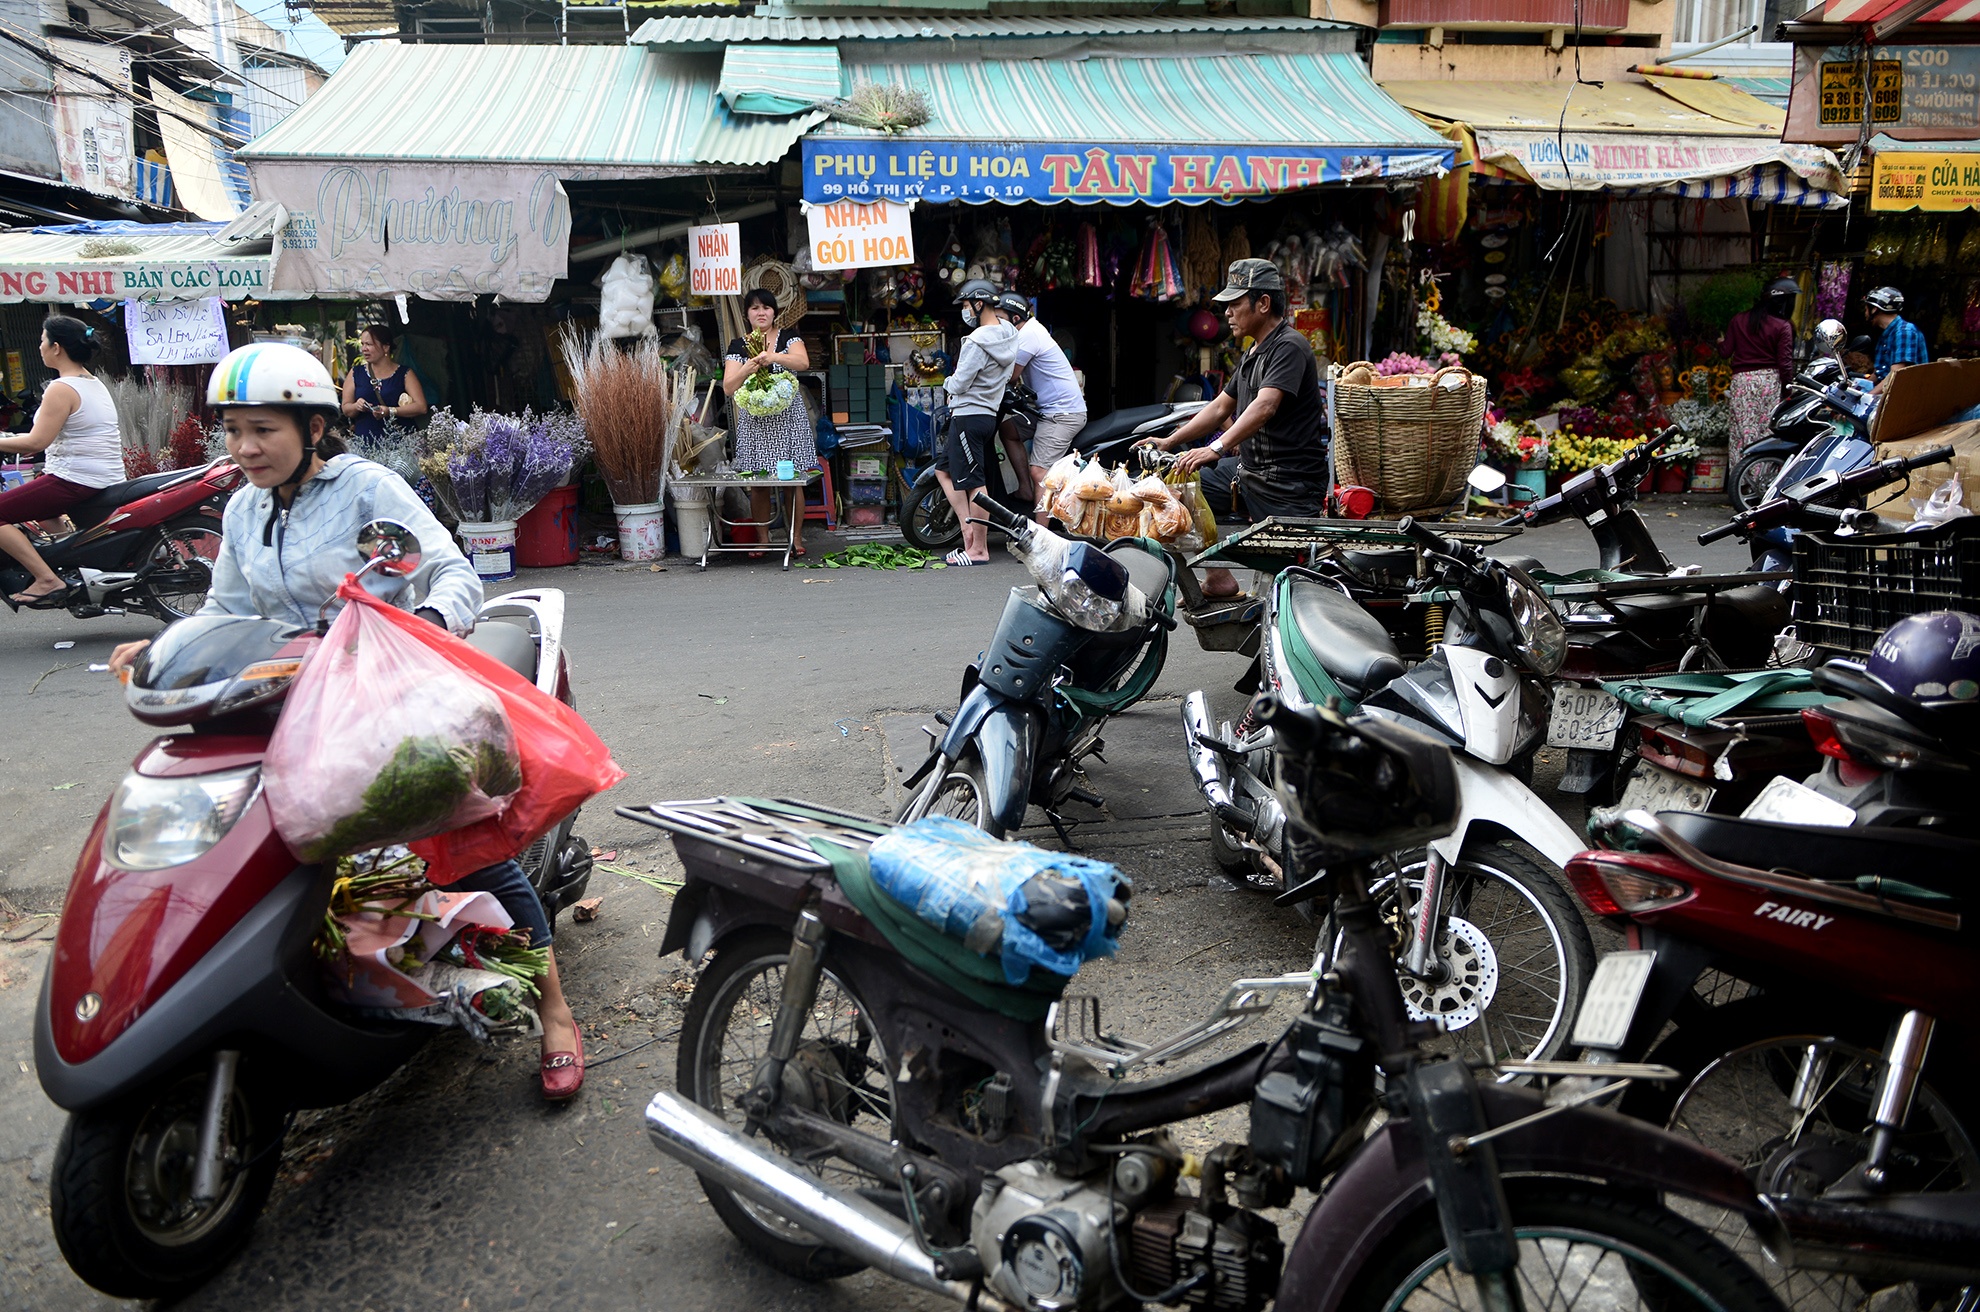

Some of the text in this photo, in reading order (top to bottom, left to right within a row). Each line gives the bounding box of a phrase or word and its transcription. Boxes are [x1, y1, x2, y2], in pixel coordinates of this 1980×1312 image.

[1875, 90, 1899, 104] 608
[1823, 107, 1851, 121] 0913
[1875, 105, 1898, 119] 608
[814, 149, 1030, 181] PHỤ LIỆU HOA
[1566, 143, 1589, 163] LAN
[1593, 144, 1652, 169] MINH
[1040, 147, 1328, 202] TÂN HẠNH
[1932, 158, 1959, 186] CỬA
[823, 183, 843, 195] 99
[848, 180, 870, 195] HỒ
[874, 184, 899, 197] THỊ
[941, 185, 955, 195] P.
[961, 185, 969, 195] 1
[984, 186, 999, 197] Q.
[1005, 185, 1024, 196] 10
[317, 166, 518, 263] Phương
[697, 229, 729, 262] NHẬN
[817, 233, 910, 265] GÓI HOA
[0, 266, 263, 295] NG NHI BÁN CÁC LOẠI
[692, 263, 738, 291] GÓI HOA
[1753, 901, 1834, 931] FAIRY
